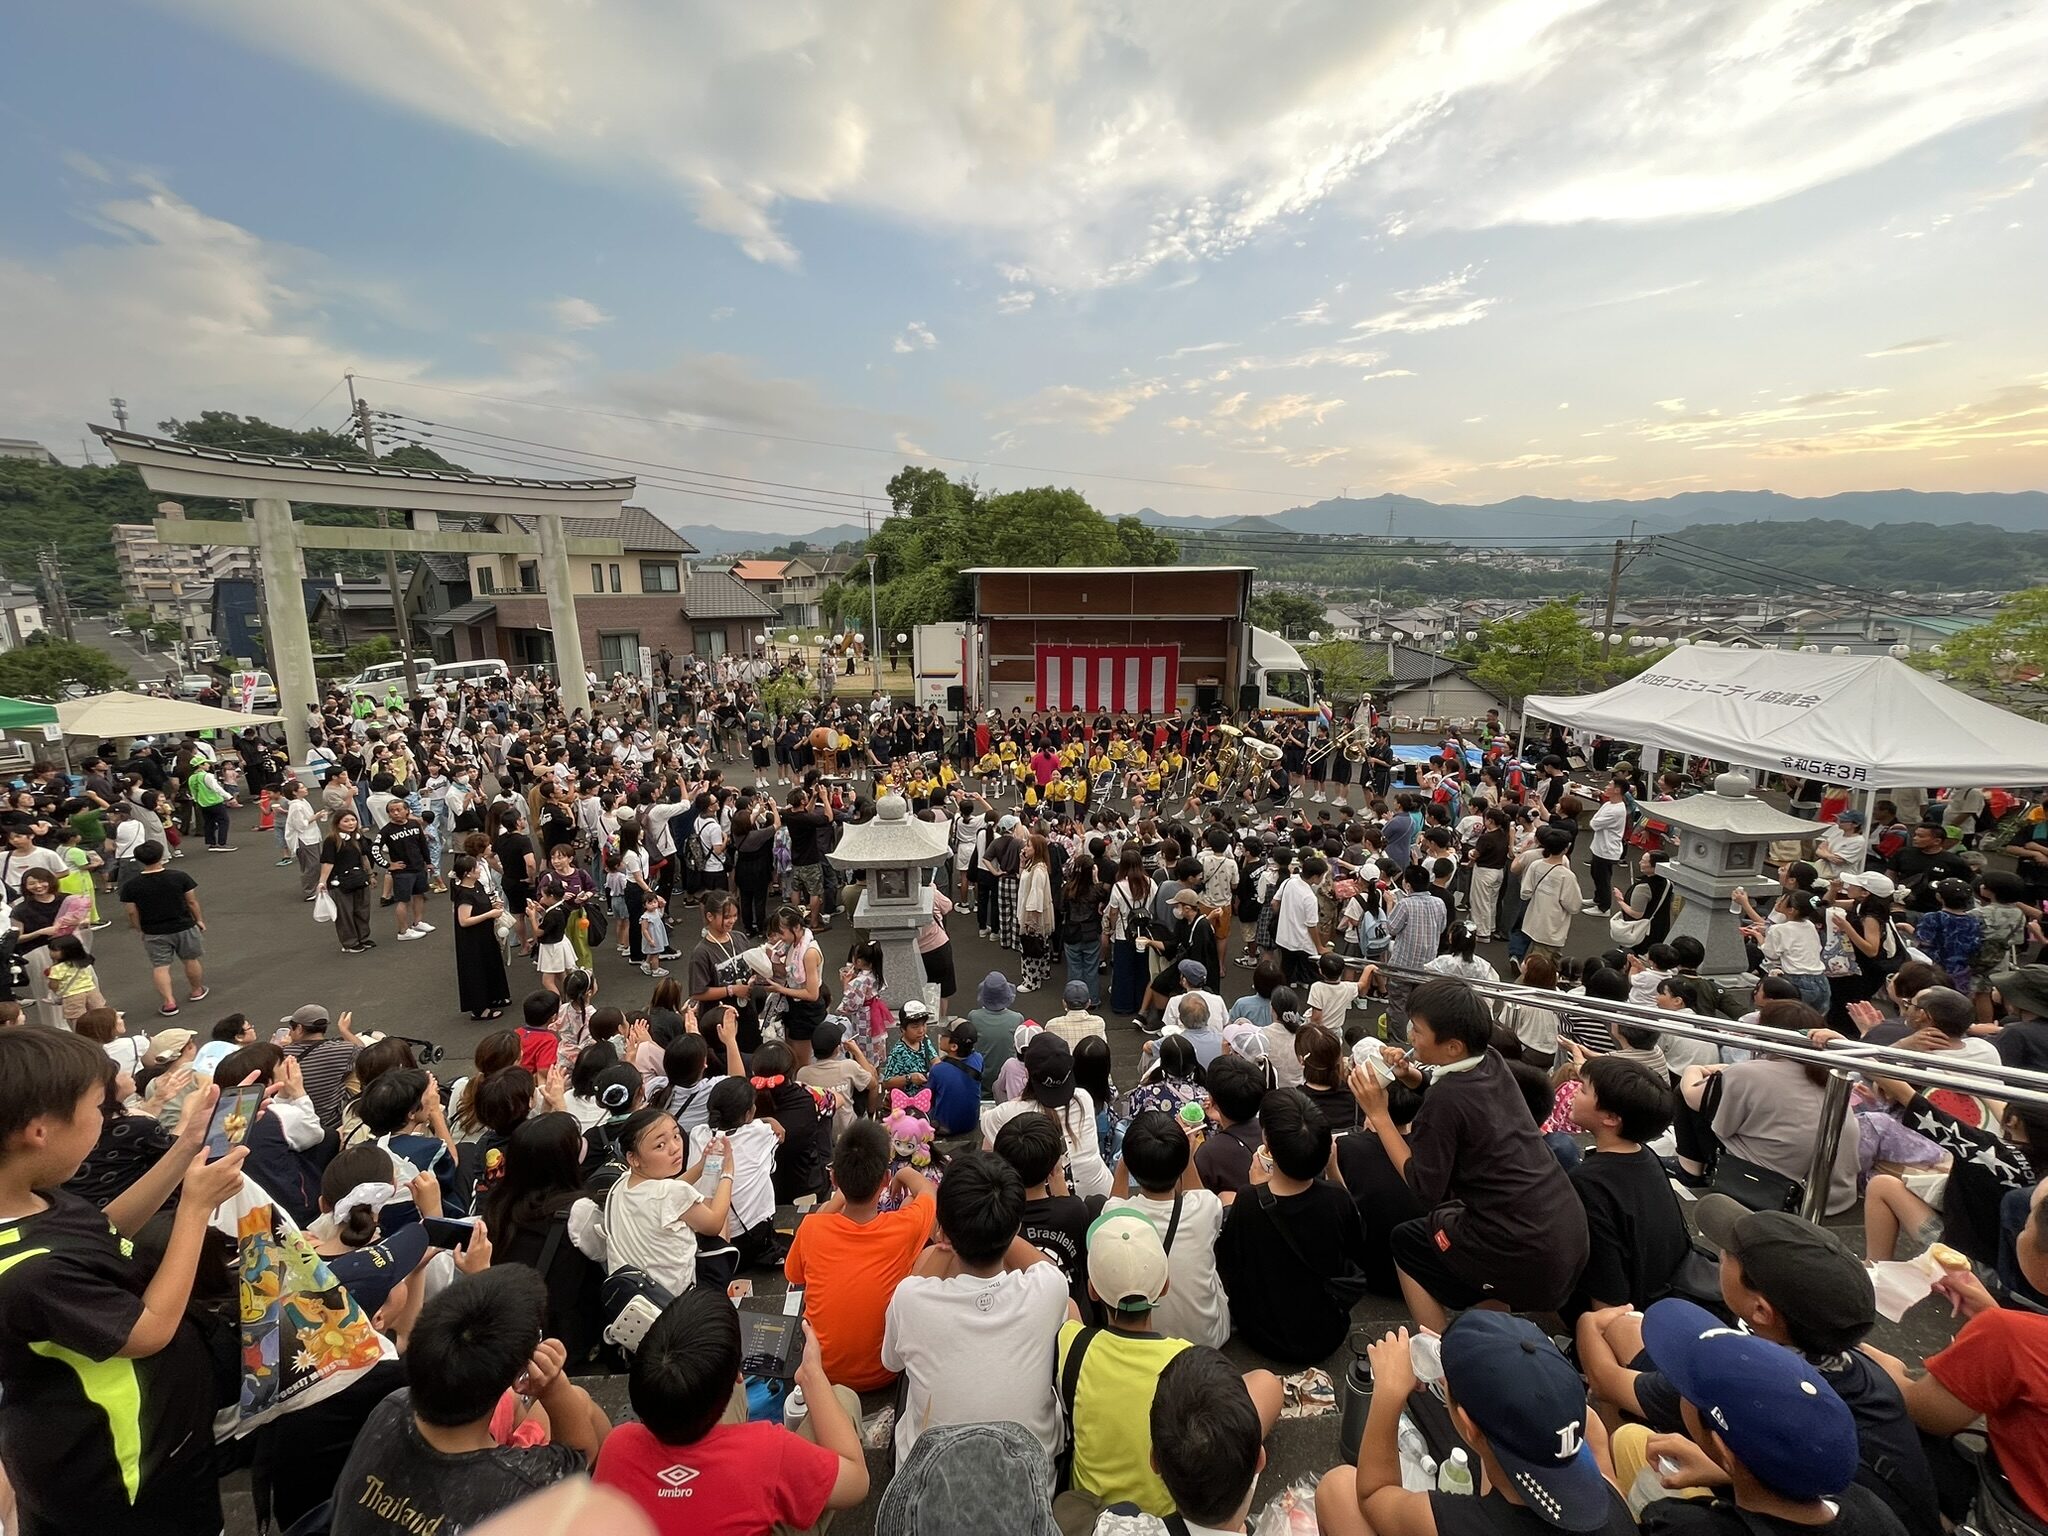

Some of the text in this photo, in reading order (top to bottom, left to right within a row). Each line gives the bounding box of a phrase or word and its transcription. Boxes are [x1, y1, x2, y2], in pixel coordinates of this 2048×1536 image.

[1636, 673, 1822, 709] 和田コミュニティ協議会
[1780, 756, 1867, 782] 令和5年3月
[1026, 1227, 1077, 1258] Brasileira
[358, 1474, 446, 1536] Thailand
[657, 1486, 693, 1498] umbro
